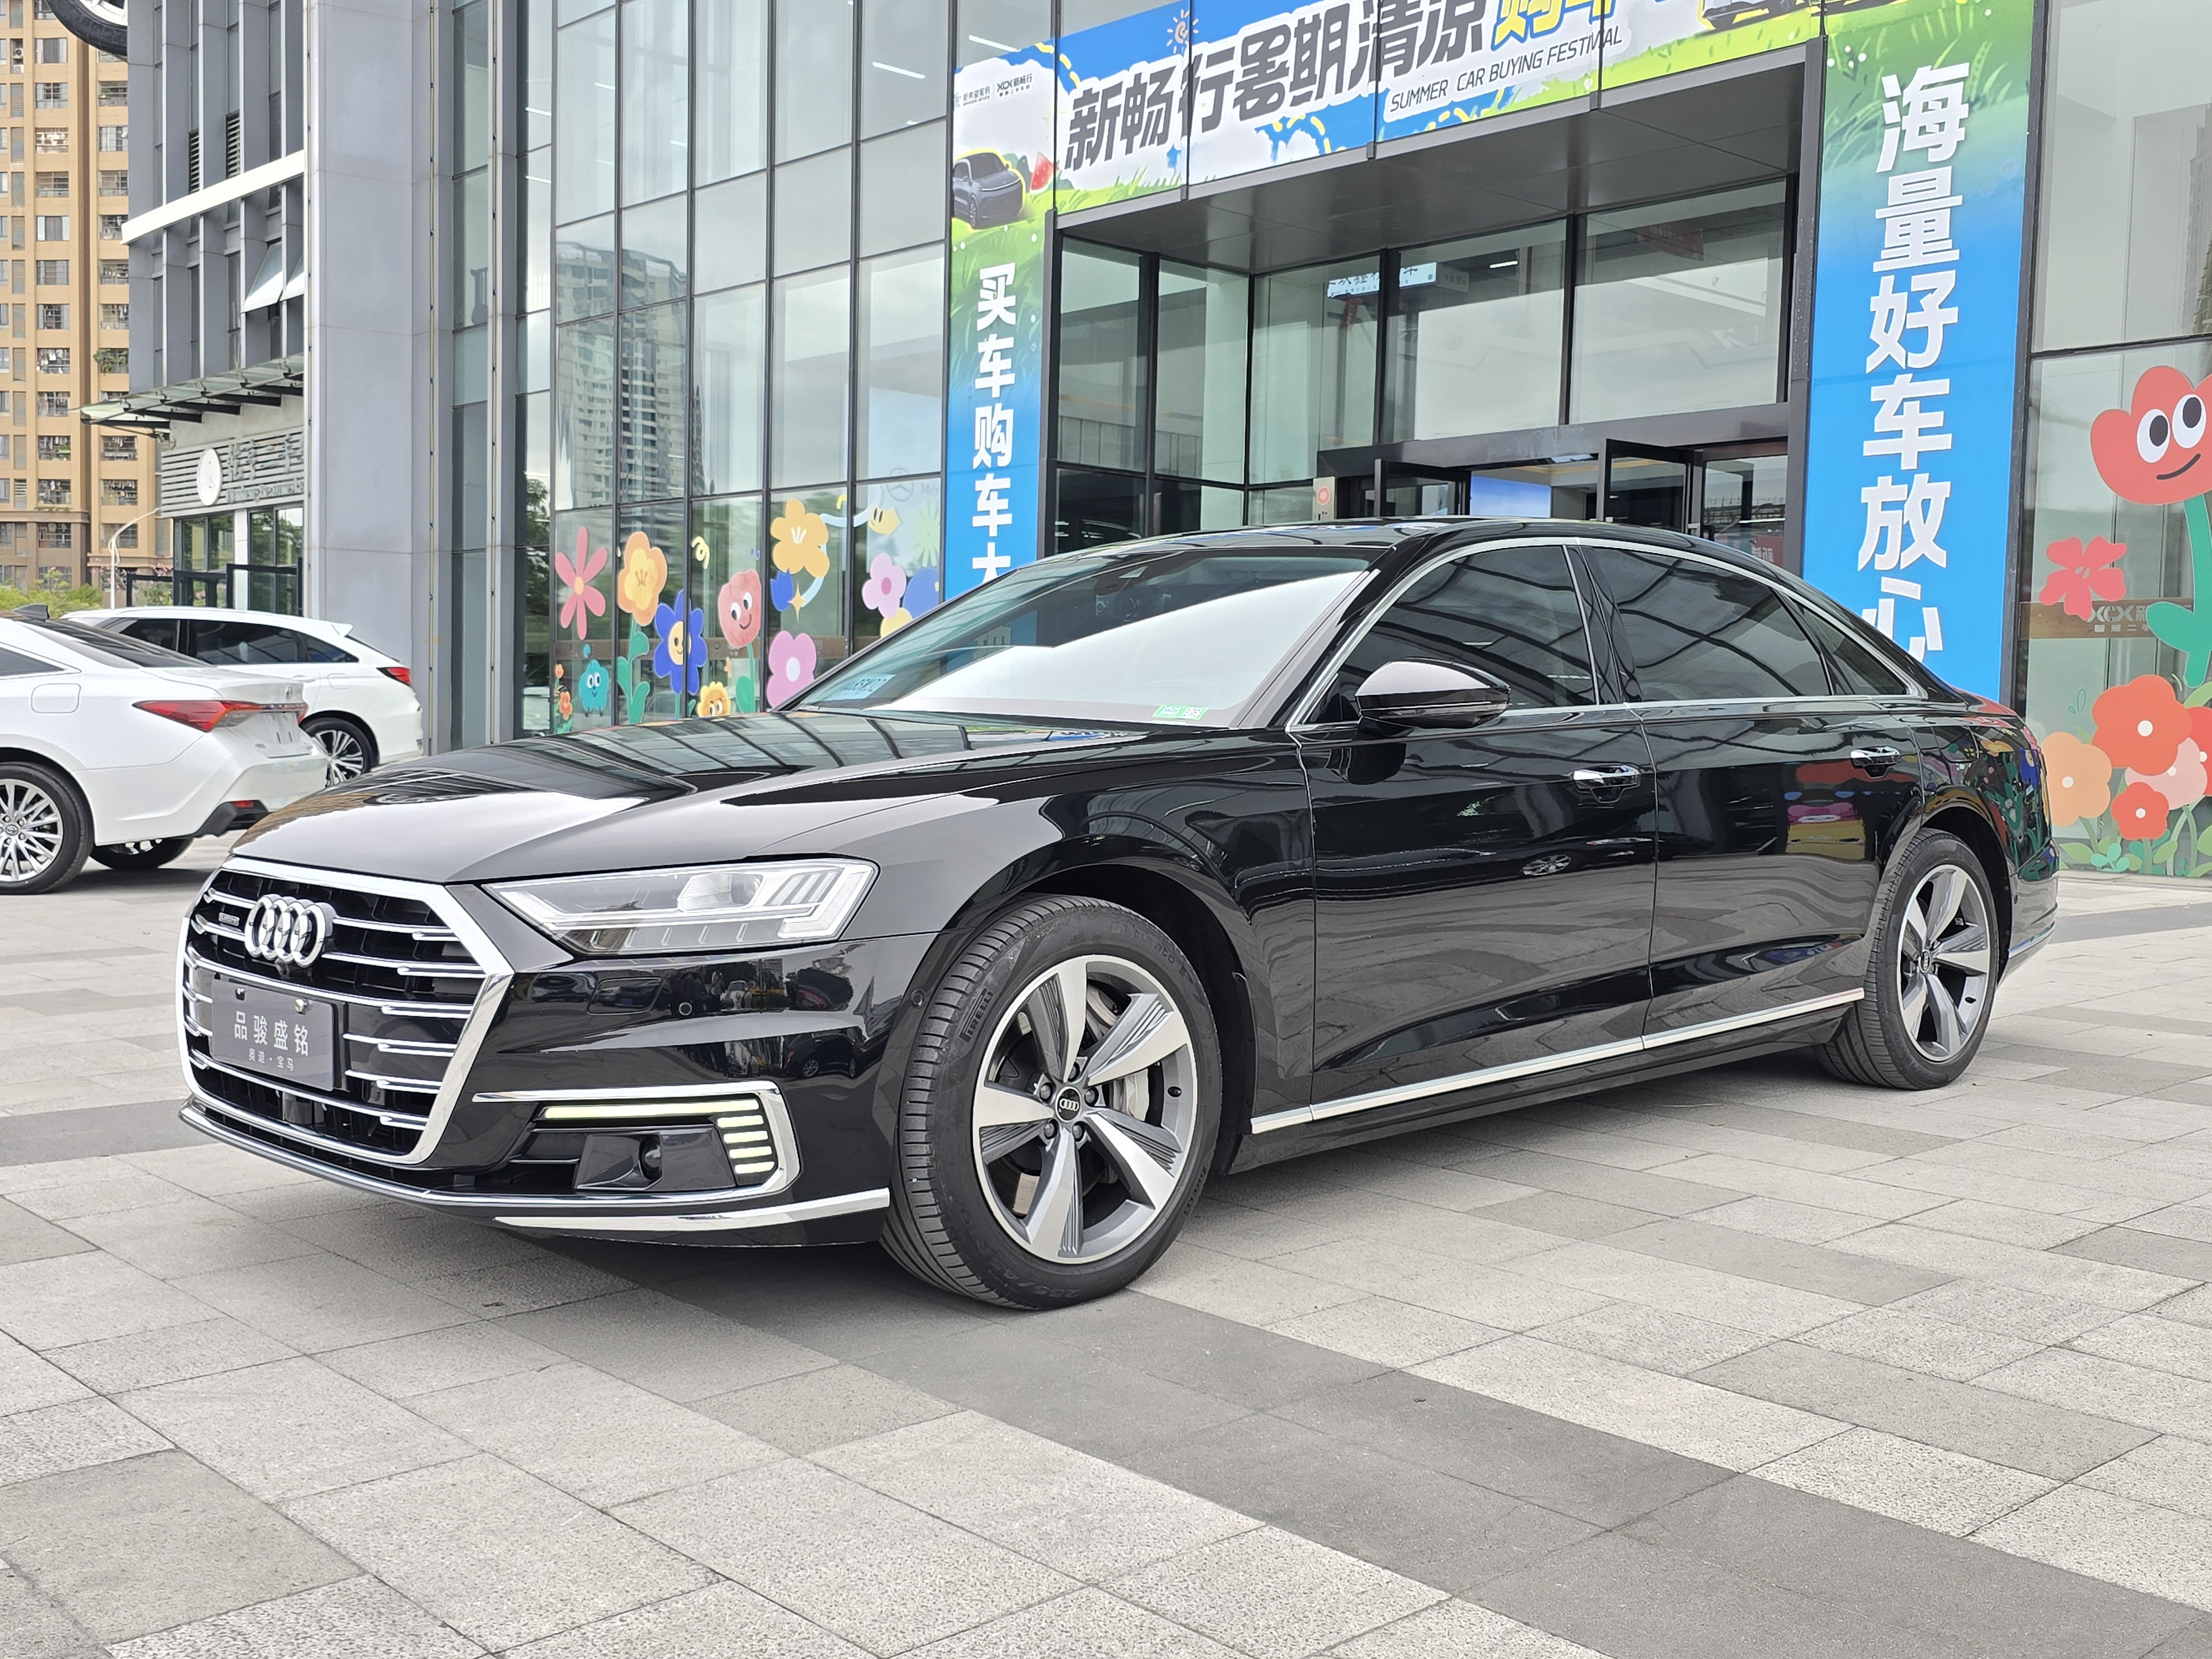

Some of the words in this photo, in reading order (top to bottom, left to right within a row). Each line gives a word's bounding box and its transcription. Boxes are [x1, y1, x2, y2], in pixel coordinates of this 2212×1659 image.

[1390, 80, 1448, 113] SUMMER
[1457, 68, 1484, 92] CAR
[1489, 50, 1543, 84] BUYING
[1547, 25, 1623, 67] FESTIVAL
[1857, 62, 1970, 664] 海量好车放心
[234, 1010, 309, 1057] 品骏盛铭
[958, 988, 994, 1043] PIRELLI
